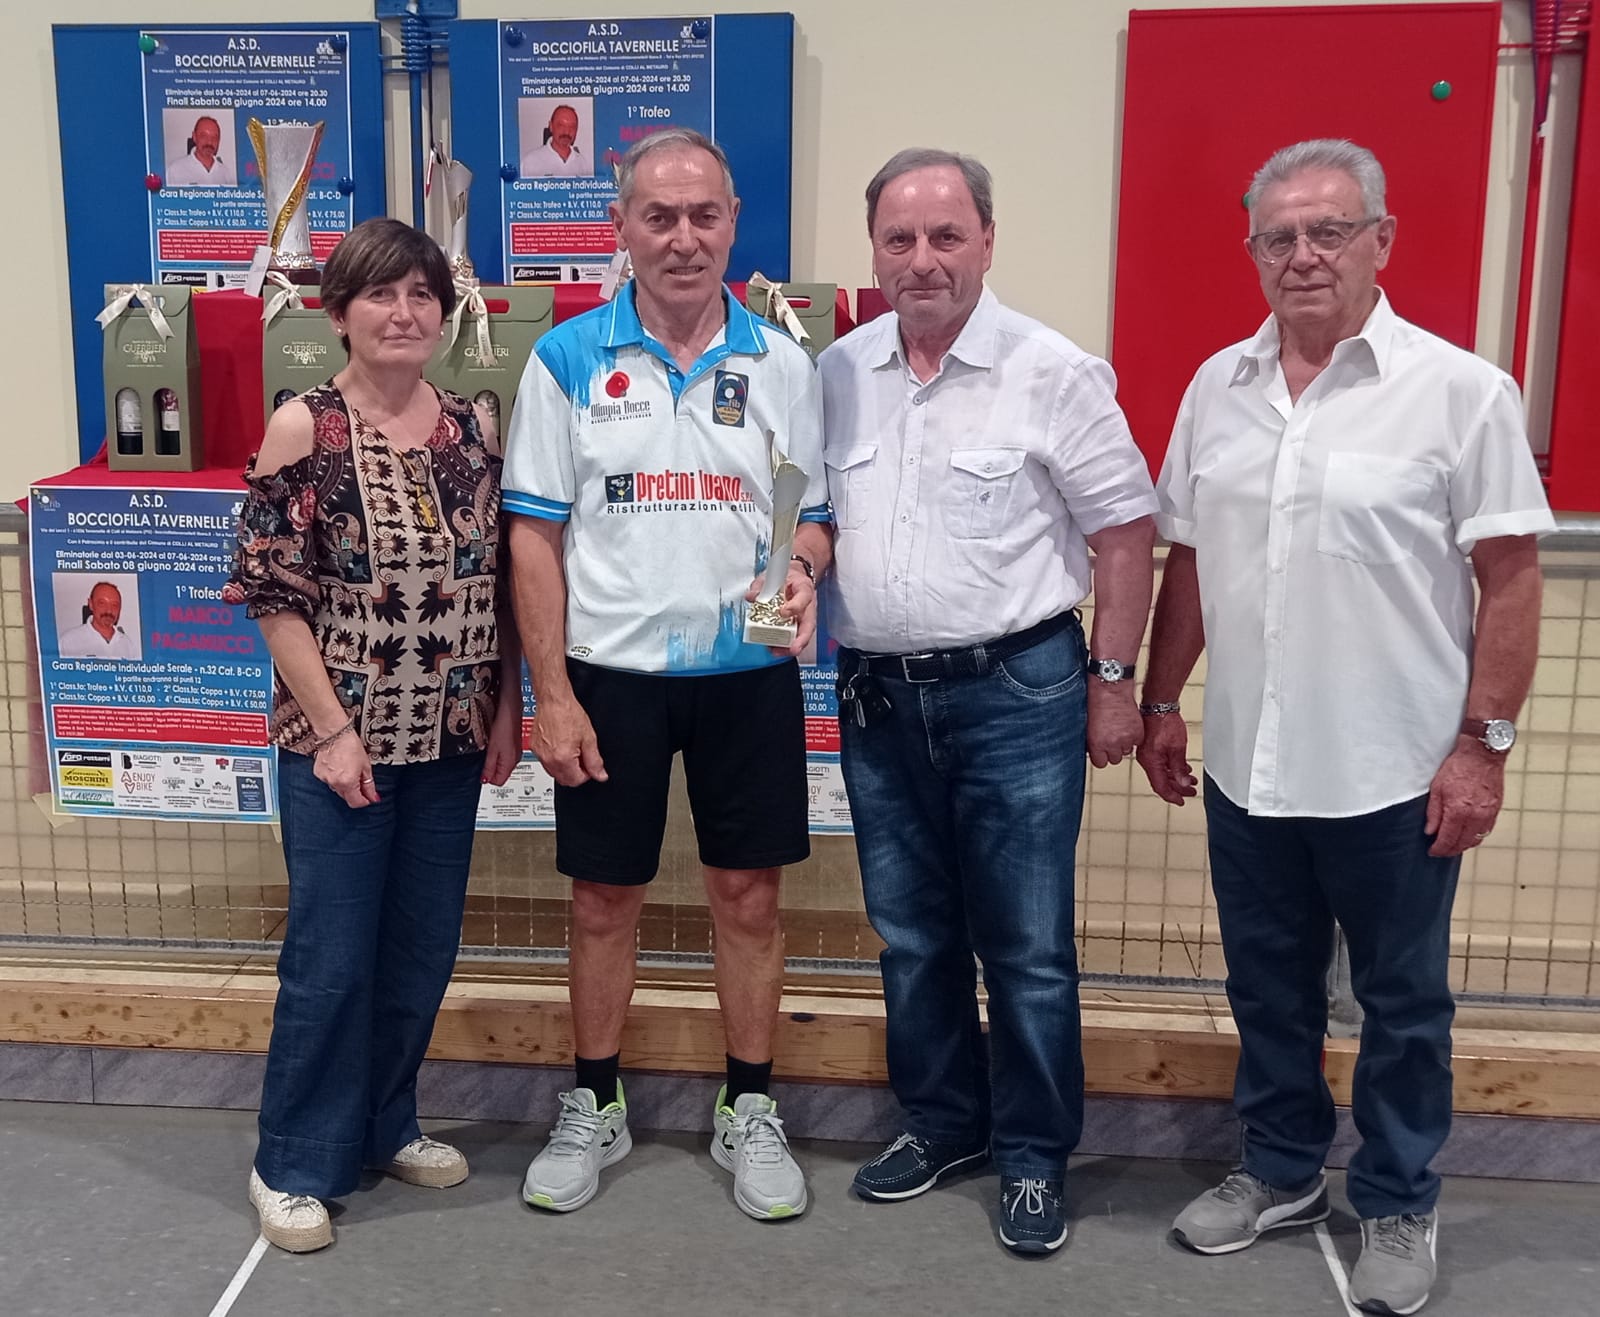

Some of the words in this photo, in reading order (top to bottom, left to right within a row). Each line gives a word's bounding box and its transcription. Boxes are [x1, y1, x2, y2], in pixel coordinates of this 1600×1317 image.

[588, 24, 622, 36] A.S.D.
[228, 38, 260, 50] A.S.D.
[533, 41, 604, 55] BOCCIOFILA
[609, 39, 679, 53] TAVERNELLE
[175, 55, 246, 68] BOCCIOFILA
[249, 55, 315, 68] TAVERNELLE
[521, 77, 560, 85] Eliminatorie
[574, 76, 611, 84] 03-06-2024
[620, 75, 658, 83] 07-06-2024
[165, 88, 202, 96] Eliminatorie
[522, 86, 545, 95] Finali
[547, 85, 579, 94] Sabato
[580, 84, 591, 93] 08
[593, 85, 624, 95] giugno
[626, 84, 647, 93] 2024
[667, 84, 690, 92] 14.00
[167, 97, 188, 105] Finali
[190, 97, 220, 105] Sabato
[221, 97, 232, 105] 08
[234, 97, 263, 107] giugno
[265, 97, 286, 106] 2024
[305, 98, 327, 106] 14.00
[640, 105, 671, 118] Trofeo
[513, 181, 532, 191] Gara
[533, 180, 571, 191] Regionale
[572, 180, 614, 190] Individuale
[159, 190, 178, 199] Gara
[179, 190, 215, 201] Regionale
[216, 190, 255, 199] Individuale
[319, 191, 341, 200] B-C-D
[542, 211, 564, 219] Coppa
[188, 219, 209, 227] Coppa
[282, 344, 327, 354] GUERRIERI
[591, 402, 621, 418] Olimpia
[129, 494, 168, 508] A.S.D.
[607, 501, 723, 514] Ristrutturazioni
[68, 512, 150, 527] BOCCIOFILA
[153, 514, 229, 530] TAVERNELLE
[55, 550, 99, 559] Eliminatorie
[101, 551, 114, 559] dal
[114, 551, 157, 560] 03-06-2024
[167, 552, 208, 562] 07-06-2024
[57, 560, 83, 569] Finali
[85, 560, 120, 570] Sabato
[122, 561, 135, 570] 08
[137, 560, 171, 572] giugno
[173, 562, 196, 572] 2024
[198, 564, 214, 573] ore
[217, 563, 231, 573] 14.
[189, 586, 223, 600] Trofeo
[169, 605, 233, 625] MARCO
[151, 633, 254, 654] PAGANUCCI
[52, 661, 74, 671] Gara
[75, 661, 117, 673] Regionale
[118, 663, 166, 673] Individuale
[167, 663, 193, 674] Serale
[199, 665, 217, 675] n.32
[218, 665, 236, 676] Cat.
[237, 667, 262, 678] B-C-D
[800, 670, 839, 680] dividuale
[122, 675, 142, 683] partite
[87, 683, 108, 691] Trofeo
[200, 686, 223, 696] Coppa
[87, 693, 111, 702] Coppa
[201, 697, 224, 707] Coppa
[64, 775, 109, 784] MOSCHINI
[132, 772, 156, 782] ENJOY
[136, 782, 153, 791] BIKE
